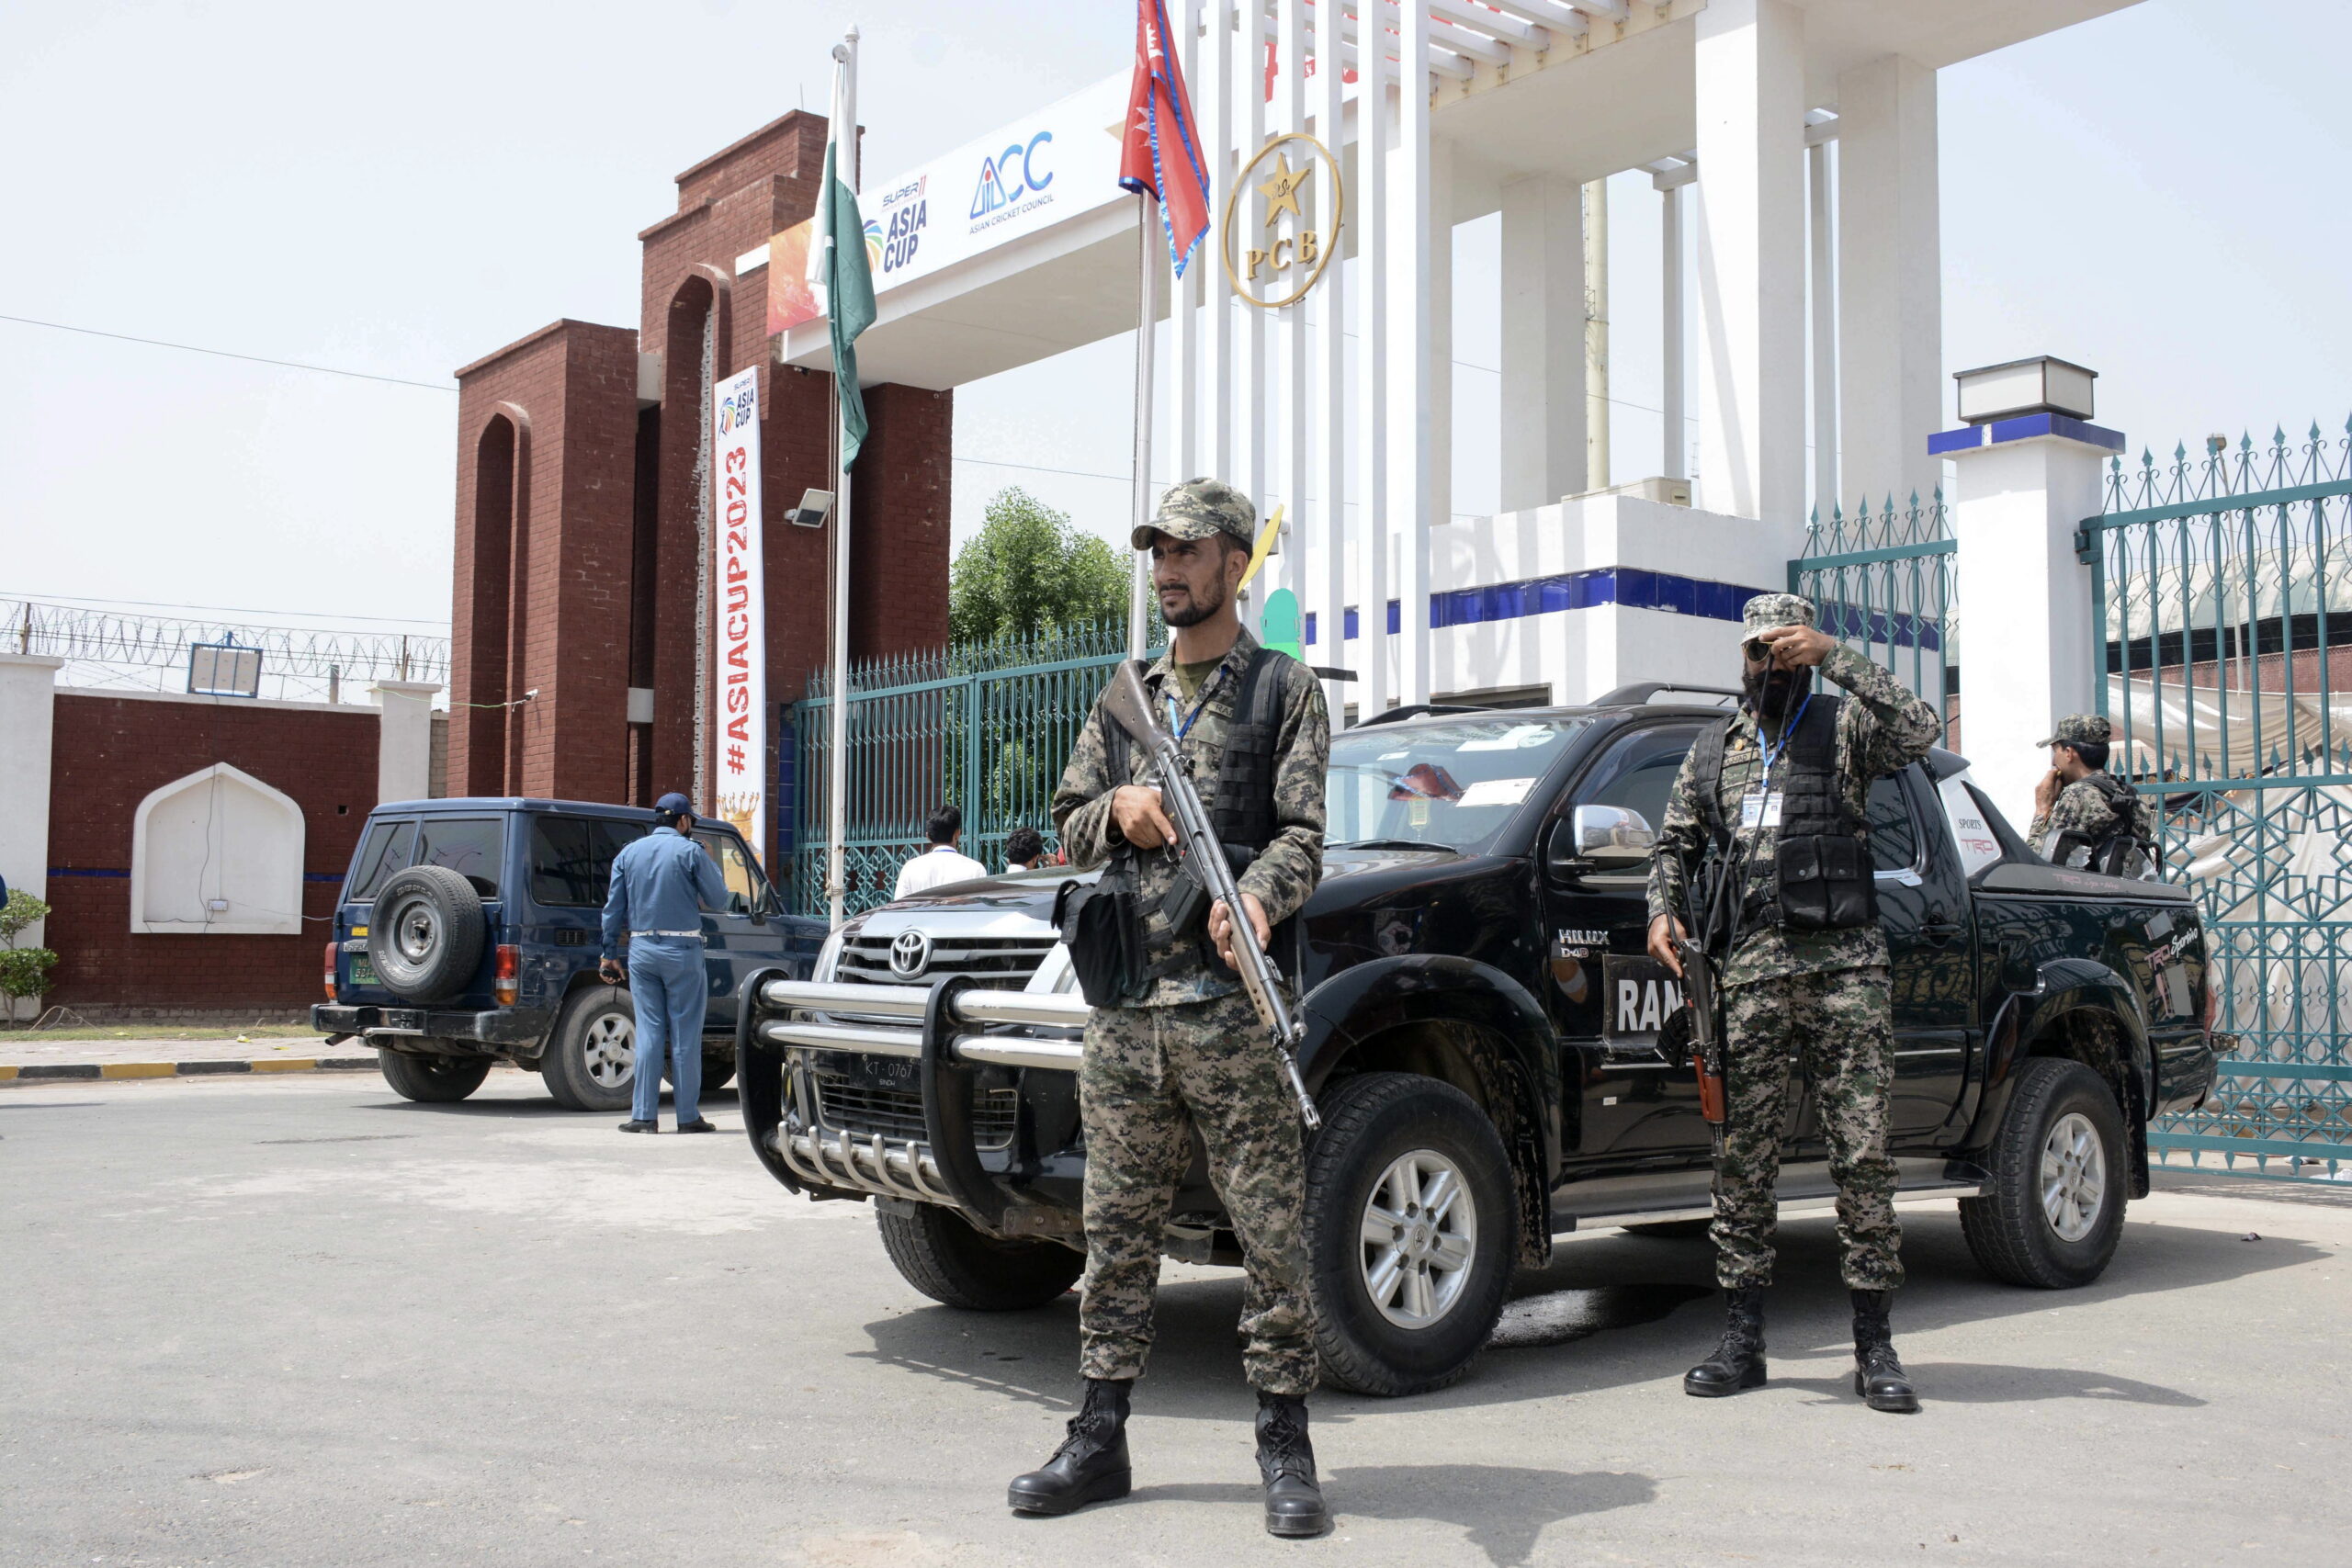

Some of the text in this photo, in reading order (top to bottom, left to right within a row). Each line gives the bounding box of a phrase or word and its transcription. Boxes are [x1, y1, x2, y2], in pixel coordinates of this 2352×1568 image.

[969, 130, 1054, 220] ACC
[887, 198, 927, 243] ASIA
[969, 194, 1055, 235] ASIAN CRICKET COUNCIL
[884, 233, 919, 273] CUP
[737, 388, 754, 411] ASIA
[736, 407, 751, 428] CUP
[727, 446, 749, 775] #ASIACUP2023
[1958, 818, 1982, 830] SPORTS
[1961, 839, 1994, 855] TRD
[1558, 929, 1611, 945] HILUX
[2170, 927, 2199, 959] Sportivo
